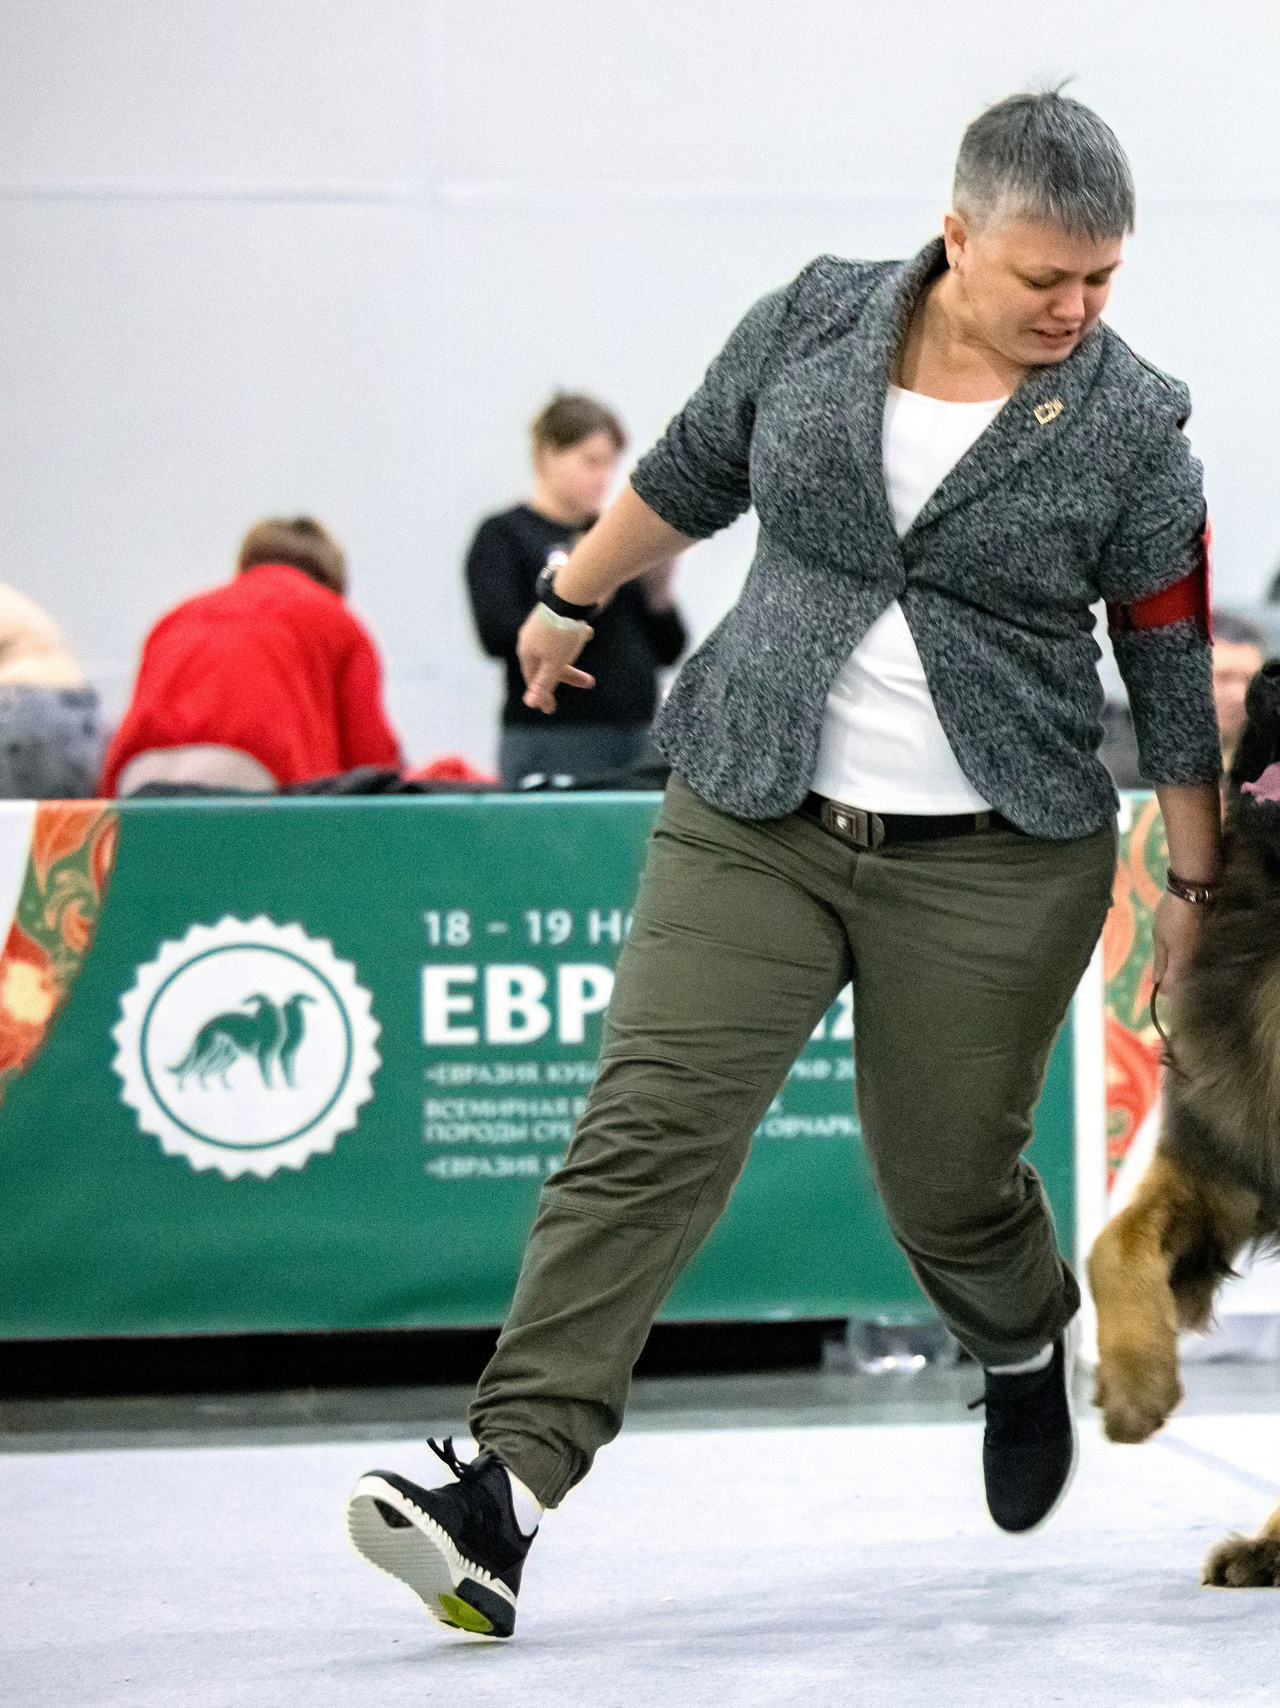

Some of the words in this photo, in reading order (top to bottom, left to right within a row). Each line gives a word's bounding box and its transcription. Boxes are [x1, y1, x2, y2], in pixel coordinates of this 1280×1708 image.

[424, 911, 471, 946] 18
[525, 910, 573, 945] 19
[421, 963, 615, 1045] ЕВР
